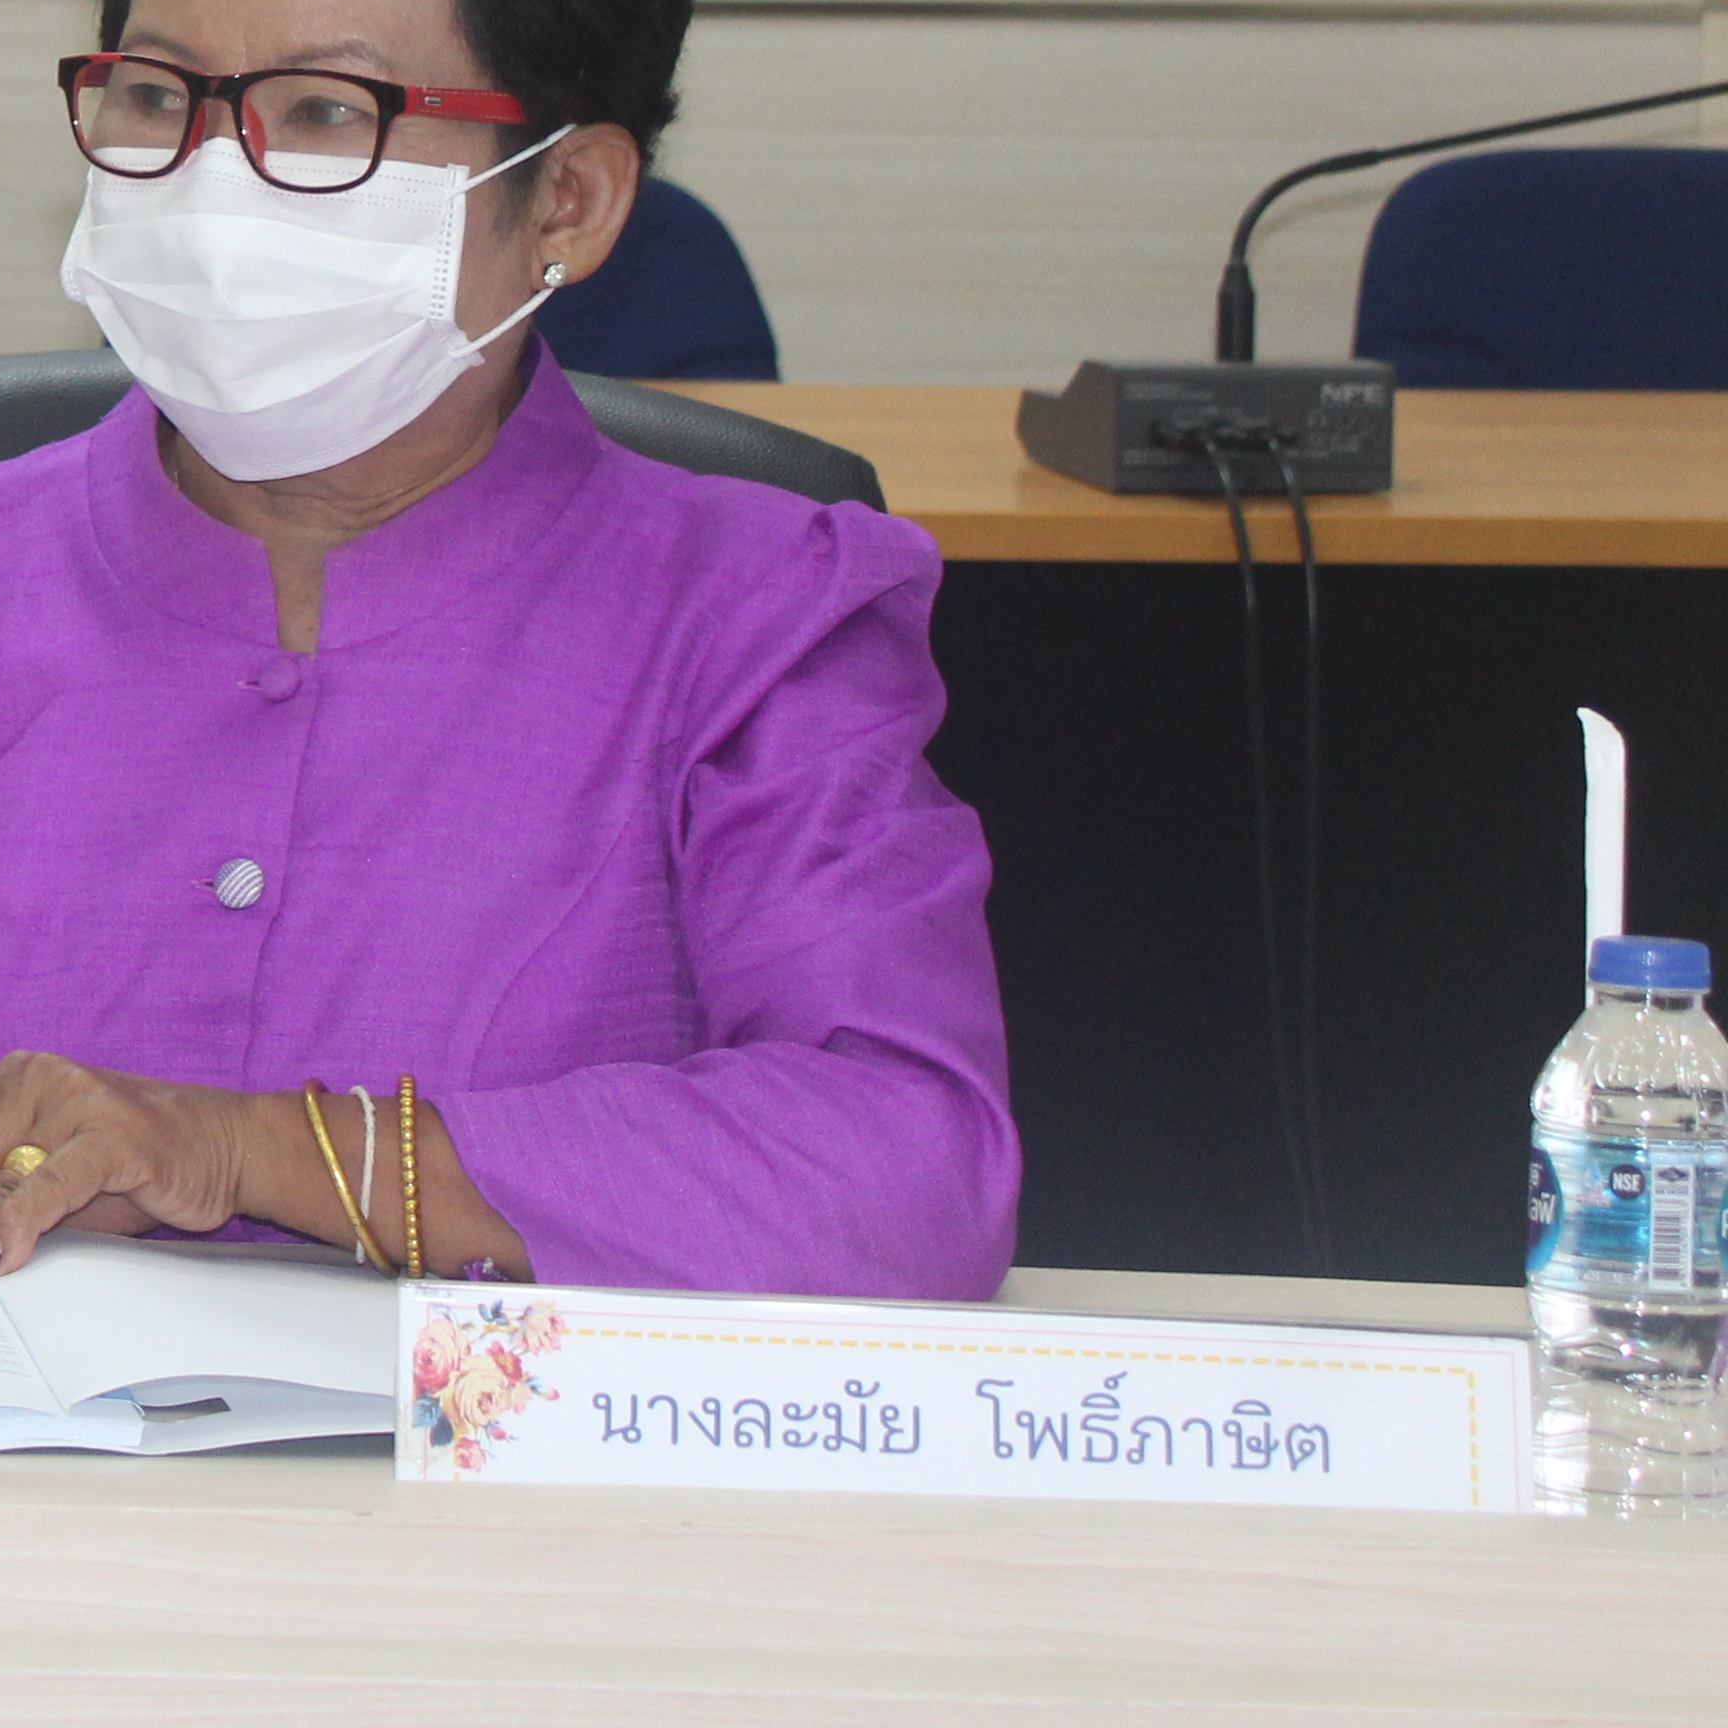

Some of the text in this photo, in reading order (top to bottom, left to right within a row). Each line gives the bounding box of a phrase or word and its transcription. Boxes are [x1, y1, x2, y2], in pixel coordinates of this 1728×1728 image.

[591, 1371, 1330, 1473] นางละมัย โพธิ์ภาษิต
